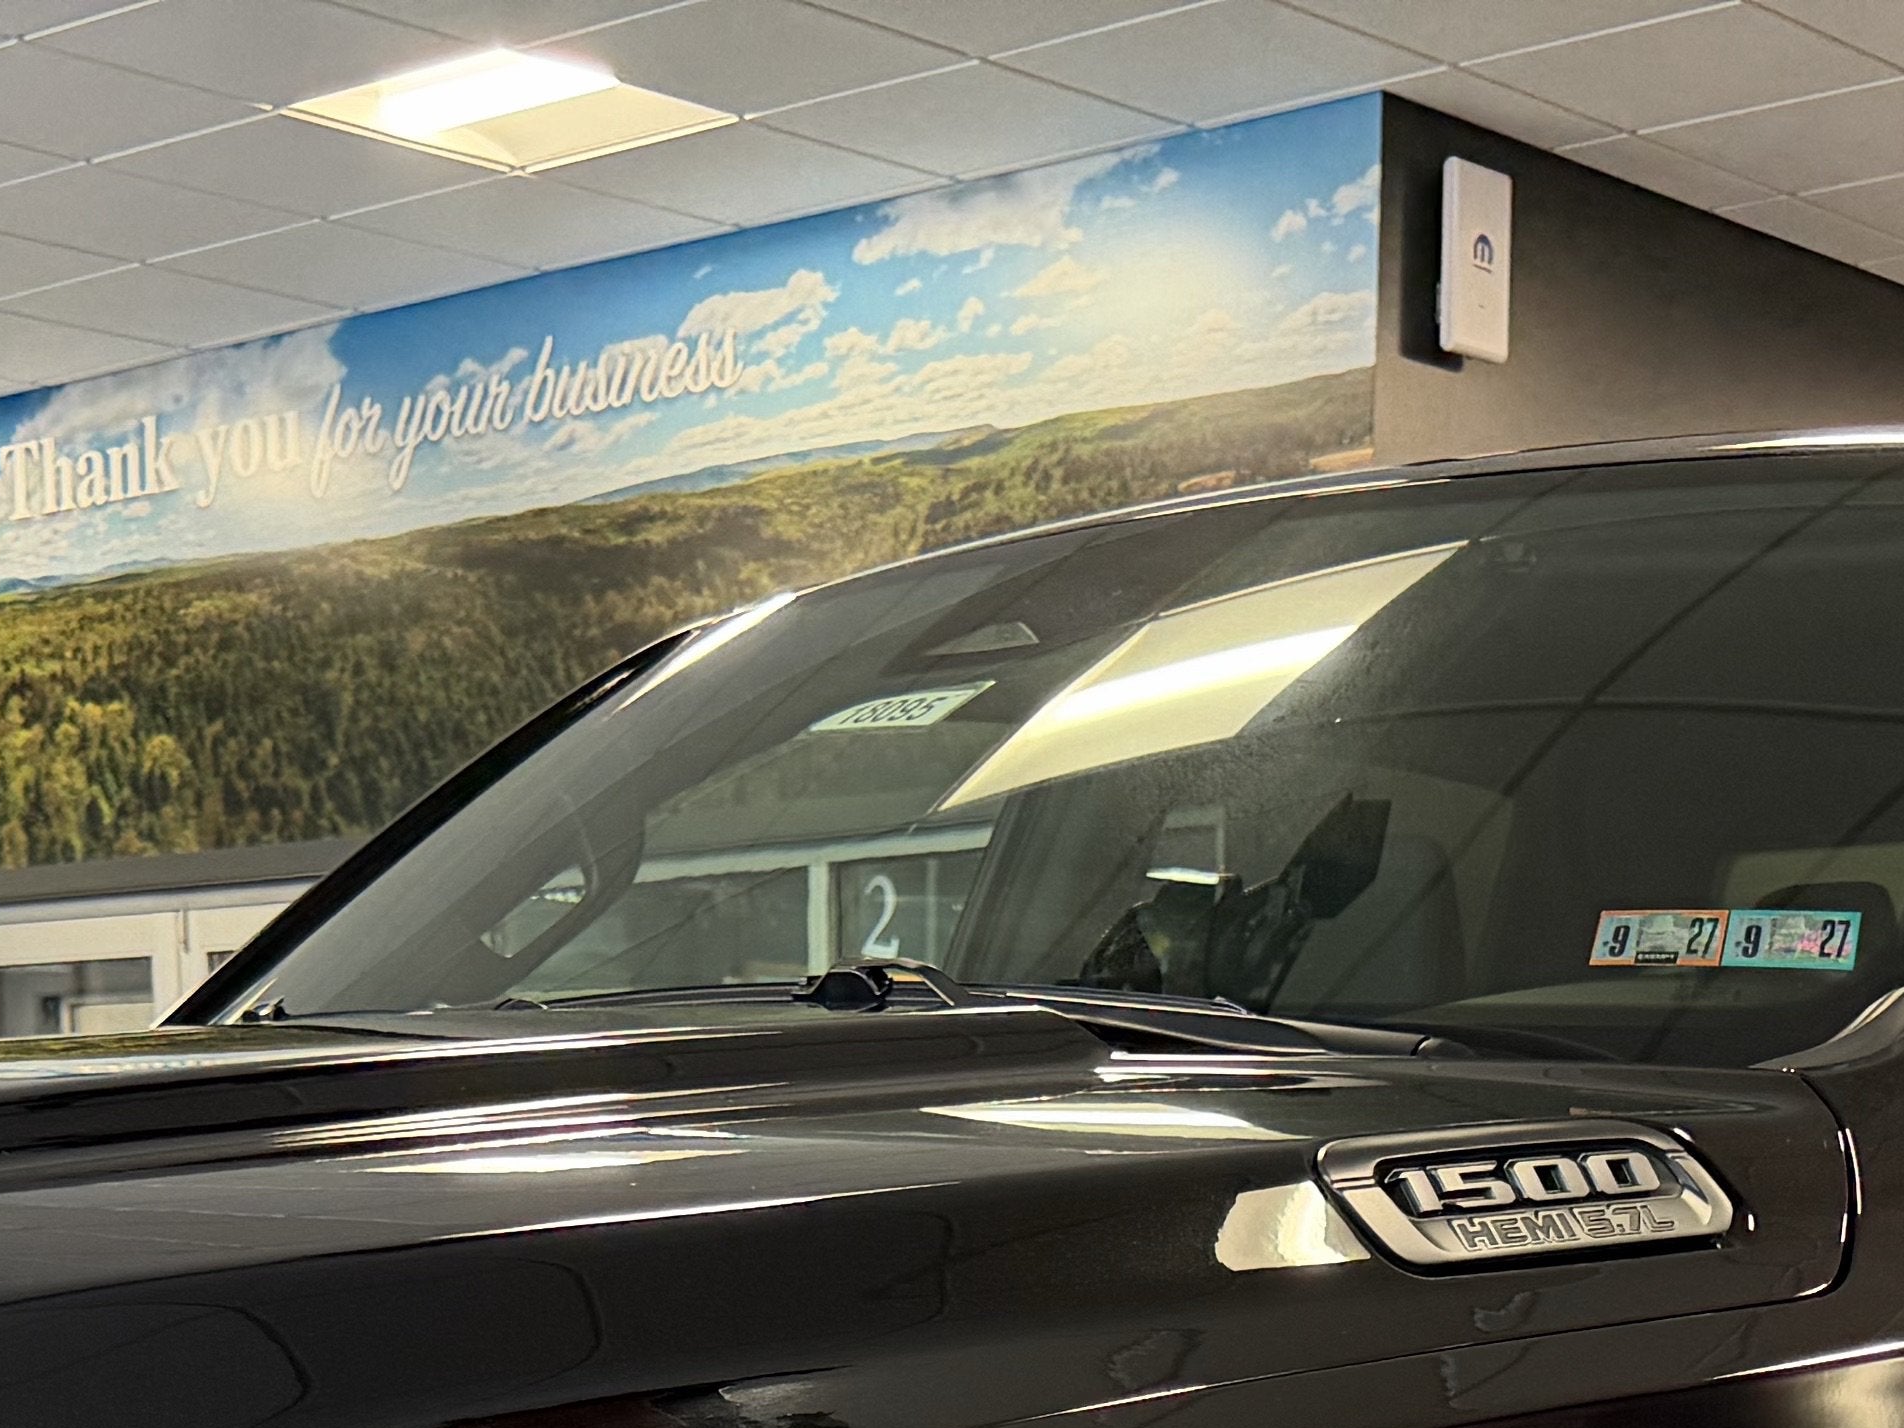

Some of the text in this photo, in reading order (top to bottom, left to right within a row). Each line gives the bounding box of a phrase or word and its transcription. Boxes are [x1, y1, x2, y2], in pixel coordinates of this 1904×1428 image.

[0, 325, 745, 523] Thank you for your business
[840, 696, 946, 725] 18095
[861, 875, 900, 959] 2
[1609, 917, 1720, 958] 9 27
[1742, 920, 1851, 959] 9 27
[1386, 1151, 1662, 1213] 1500
[1451, 1204, 1676, 1252] HEMI 5.7L
